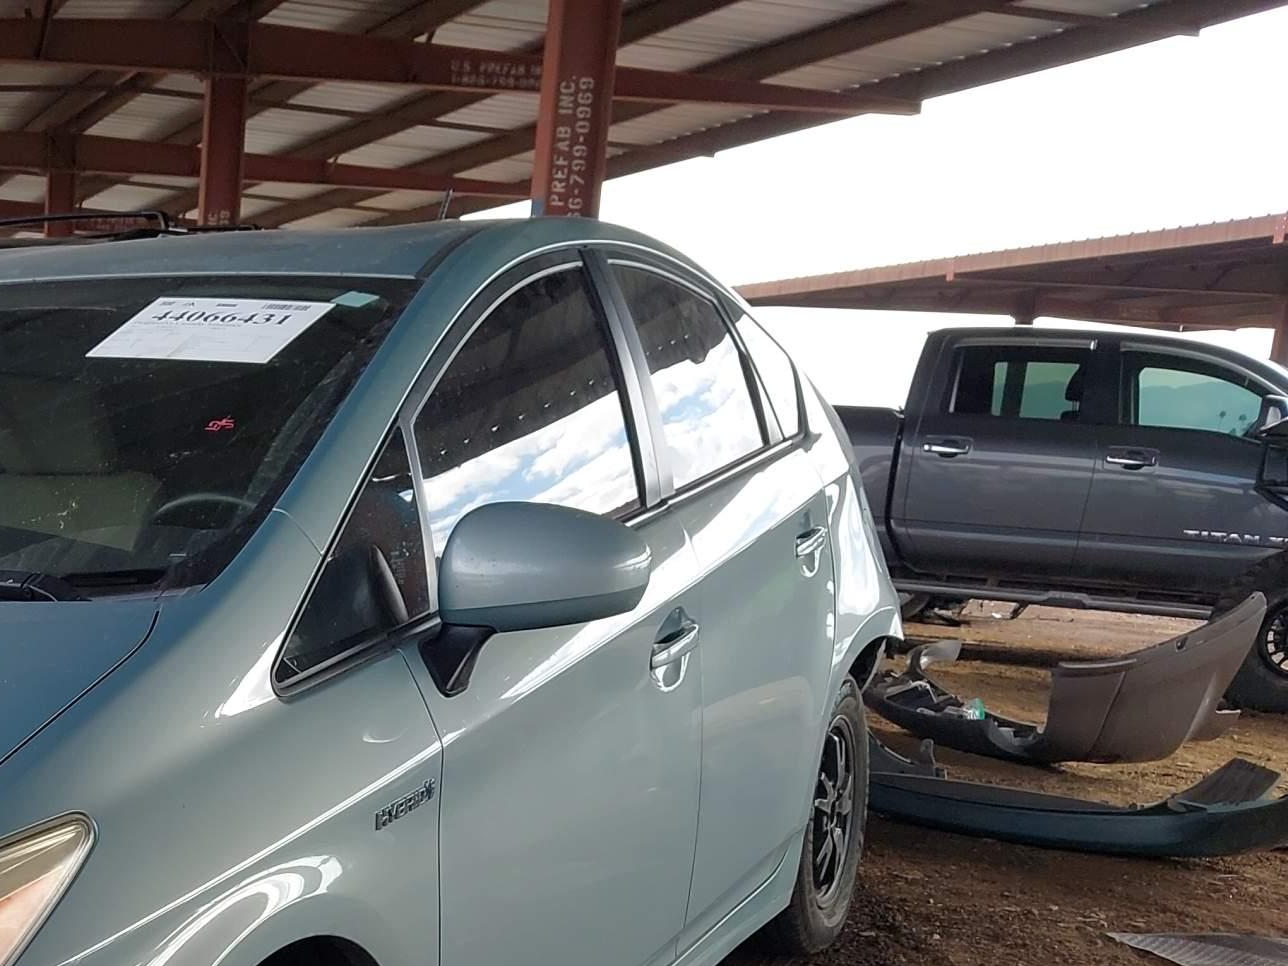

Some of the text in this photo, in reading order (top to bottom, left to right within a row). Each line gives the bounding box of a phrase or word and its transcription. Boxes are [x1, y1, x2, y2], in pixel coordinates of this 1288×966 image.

[550, 75, 576, 207] PREFAB INC.
[151, 309, 292, 326] 44066431
[1183, 528, 1261, 546] TITAN
